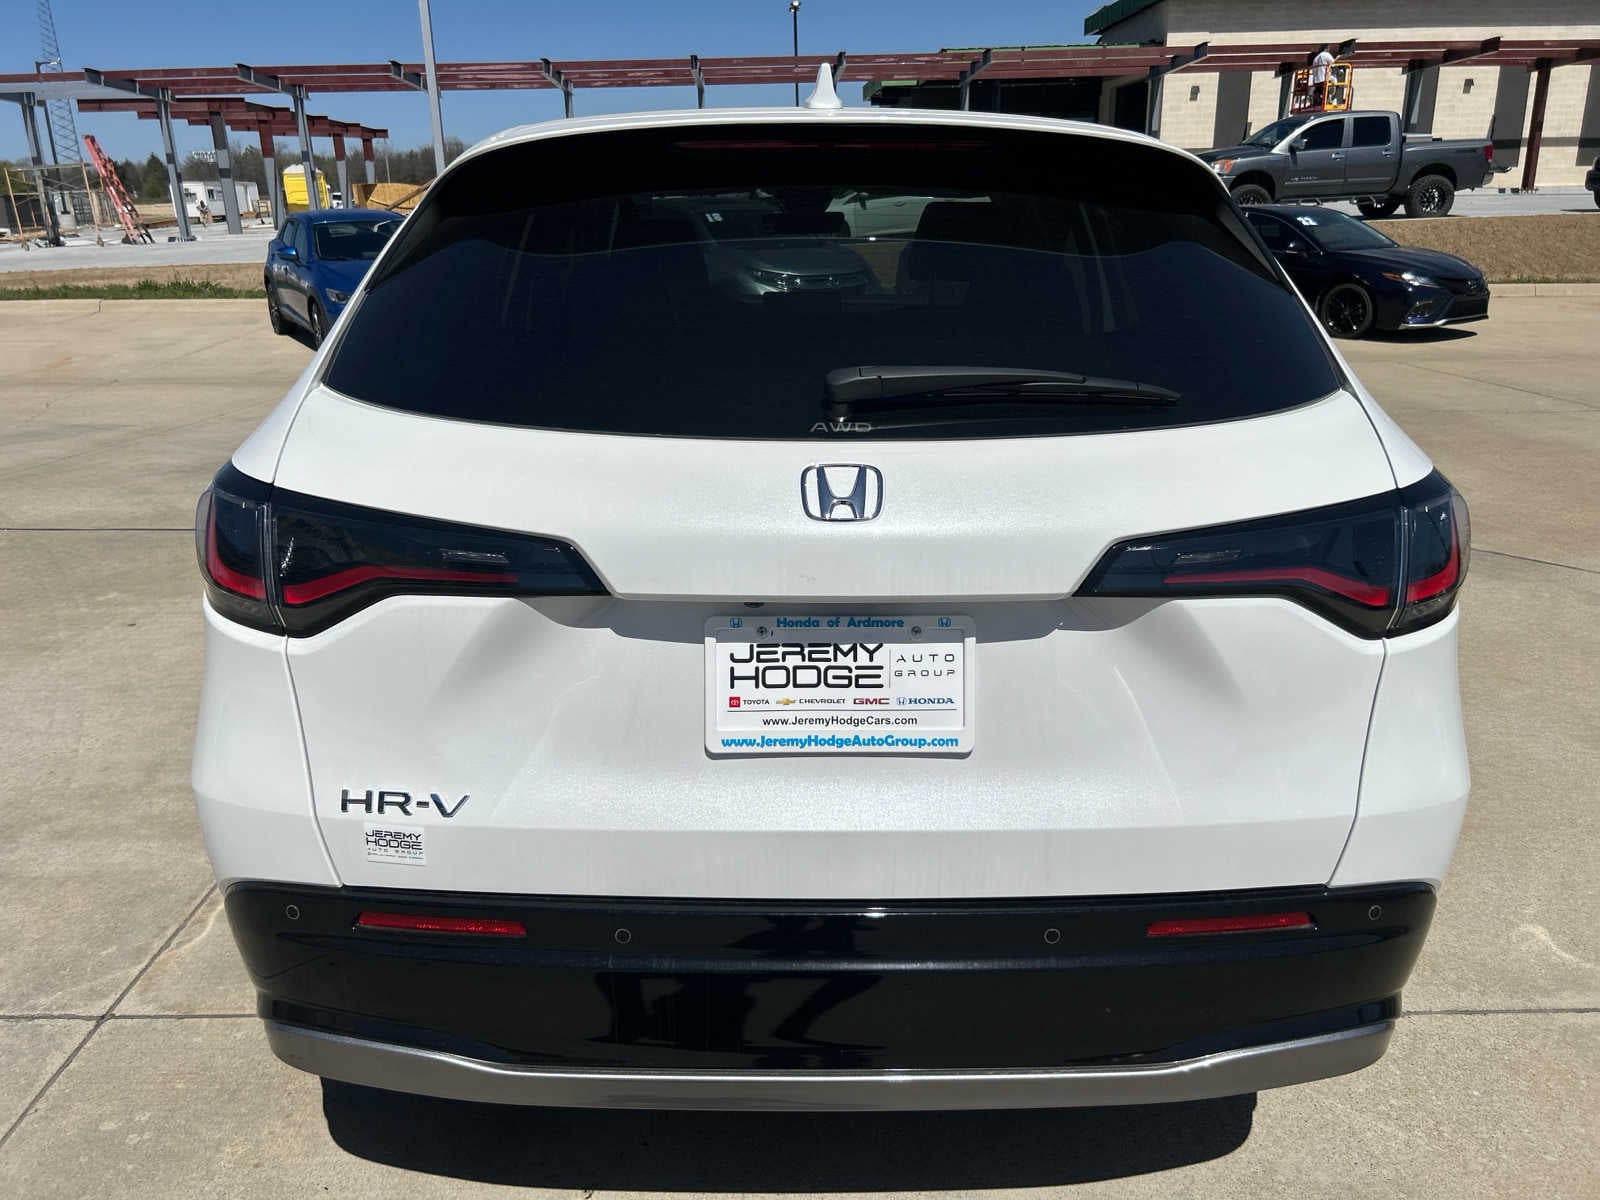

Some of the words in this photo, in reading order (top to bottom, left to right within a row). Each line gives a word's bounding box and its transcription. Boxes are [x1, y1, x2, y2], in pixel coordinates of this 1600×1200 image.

[810, 422, 872, 432] AWD
[776, 617, 820, 628] Honda
[826, 616, 840, 628] of
[847, 617, 905, 628] Ardmore
[729, 643, 884, 664] JEREMY
[896, 653, 955, 663] AUTO
[729, 665, 884, 690] HODGE
[894, 669, 956, 677] GROUP
[853, 697, 890, 705] GMC
[908, 697, 955, 705] HONDA
[762, 715, 918, 727] www.JeremyHodgeCars.com
[721, 734, 959, 749] www.JeremyHodgeAutoGroup.com
[341, 788, 470, 818] HR-V
[365, 829, 422, 841] JEREMY
[365, 837, 423, 851] HODGE
